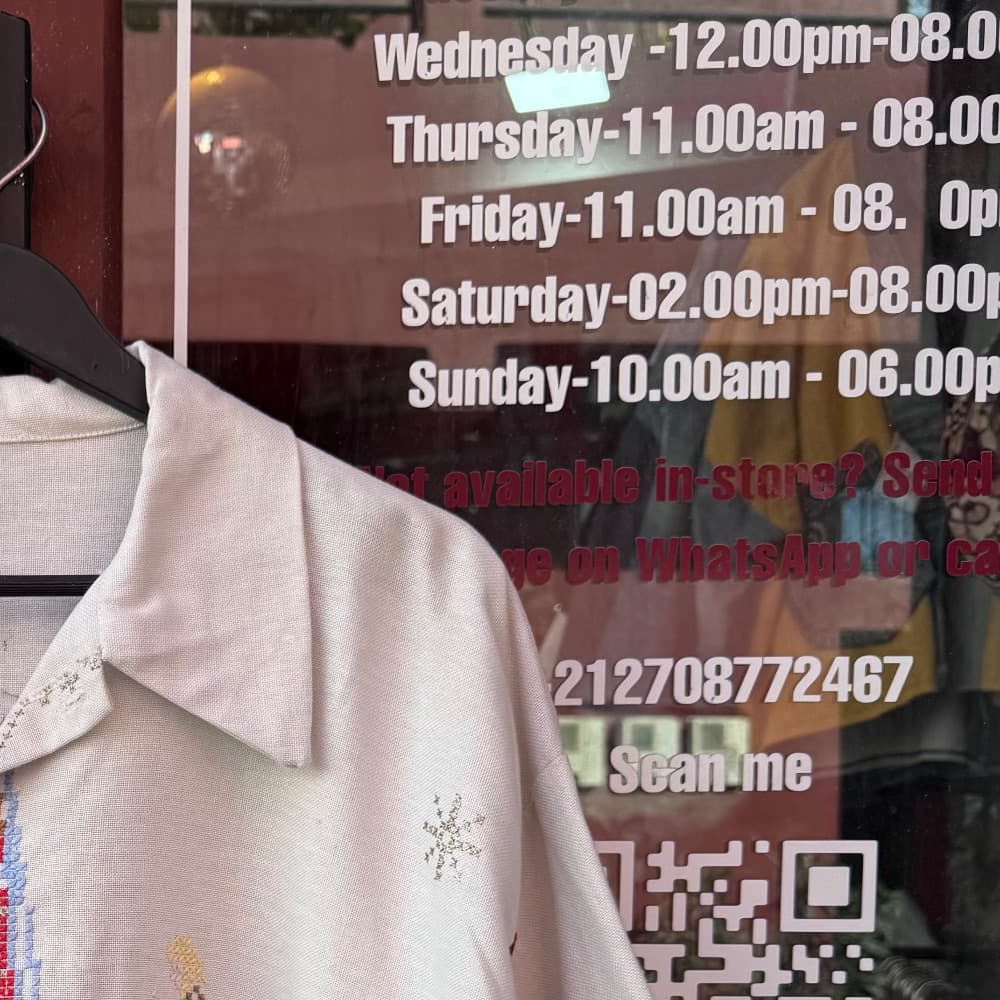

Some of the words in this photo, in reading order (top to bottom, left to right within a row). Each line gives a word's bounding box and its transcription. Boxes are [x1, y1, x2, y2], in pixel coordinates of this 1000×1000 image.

[374, 26, 633, 84] Wednesday
[650, 10, 1000, 74] -12.00pm-08.0
[387, 102, 825, 166] Thursday-11.00am
[420, 187, 785, 249] Friday-11.00am
[939, 180, 1000, 237] 0p
[408, 352, 791, 413] Sunday-10.00am
[838, 347, 1000, 403] 06.00p
[443, 458, 640, 508] available
[655, 452, 866, 503] in-store?
[882, 450, 993, 499] Send
[566, 545, 620, 586] on
[635, 533, 861, 588] WhatsApp
[878, 539, 931, 579] or
[549, 655, 915, 706] 212708772467
[609, 745, 727, 795] Scan
[739, 752, 813, 793] me
